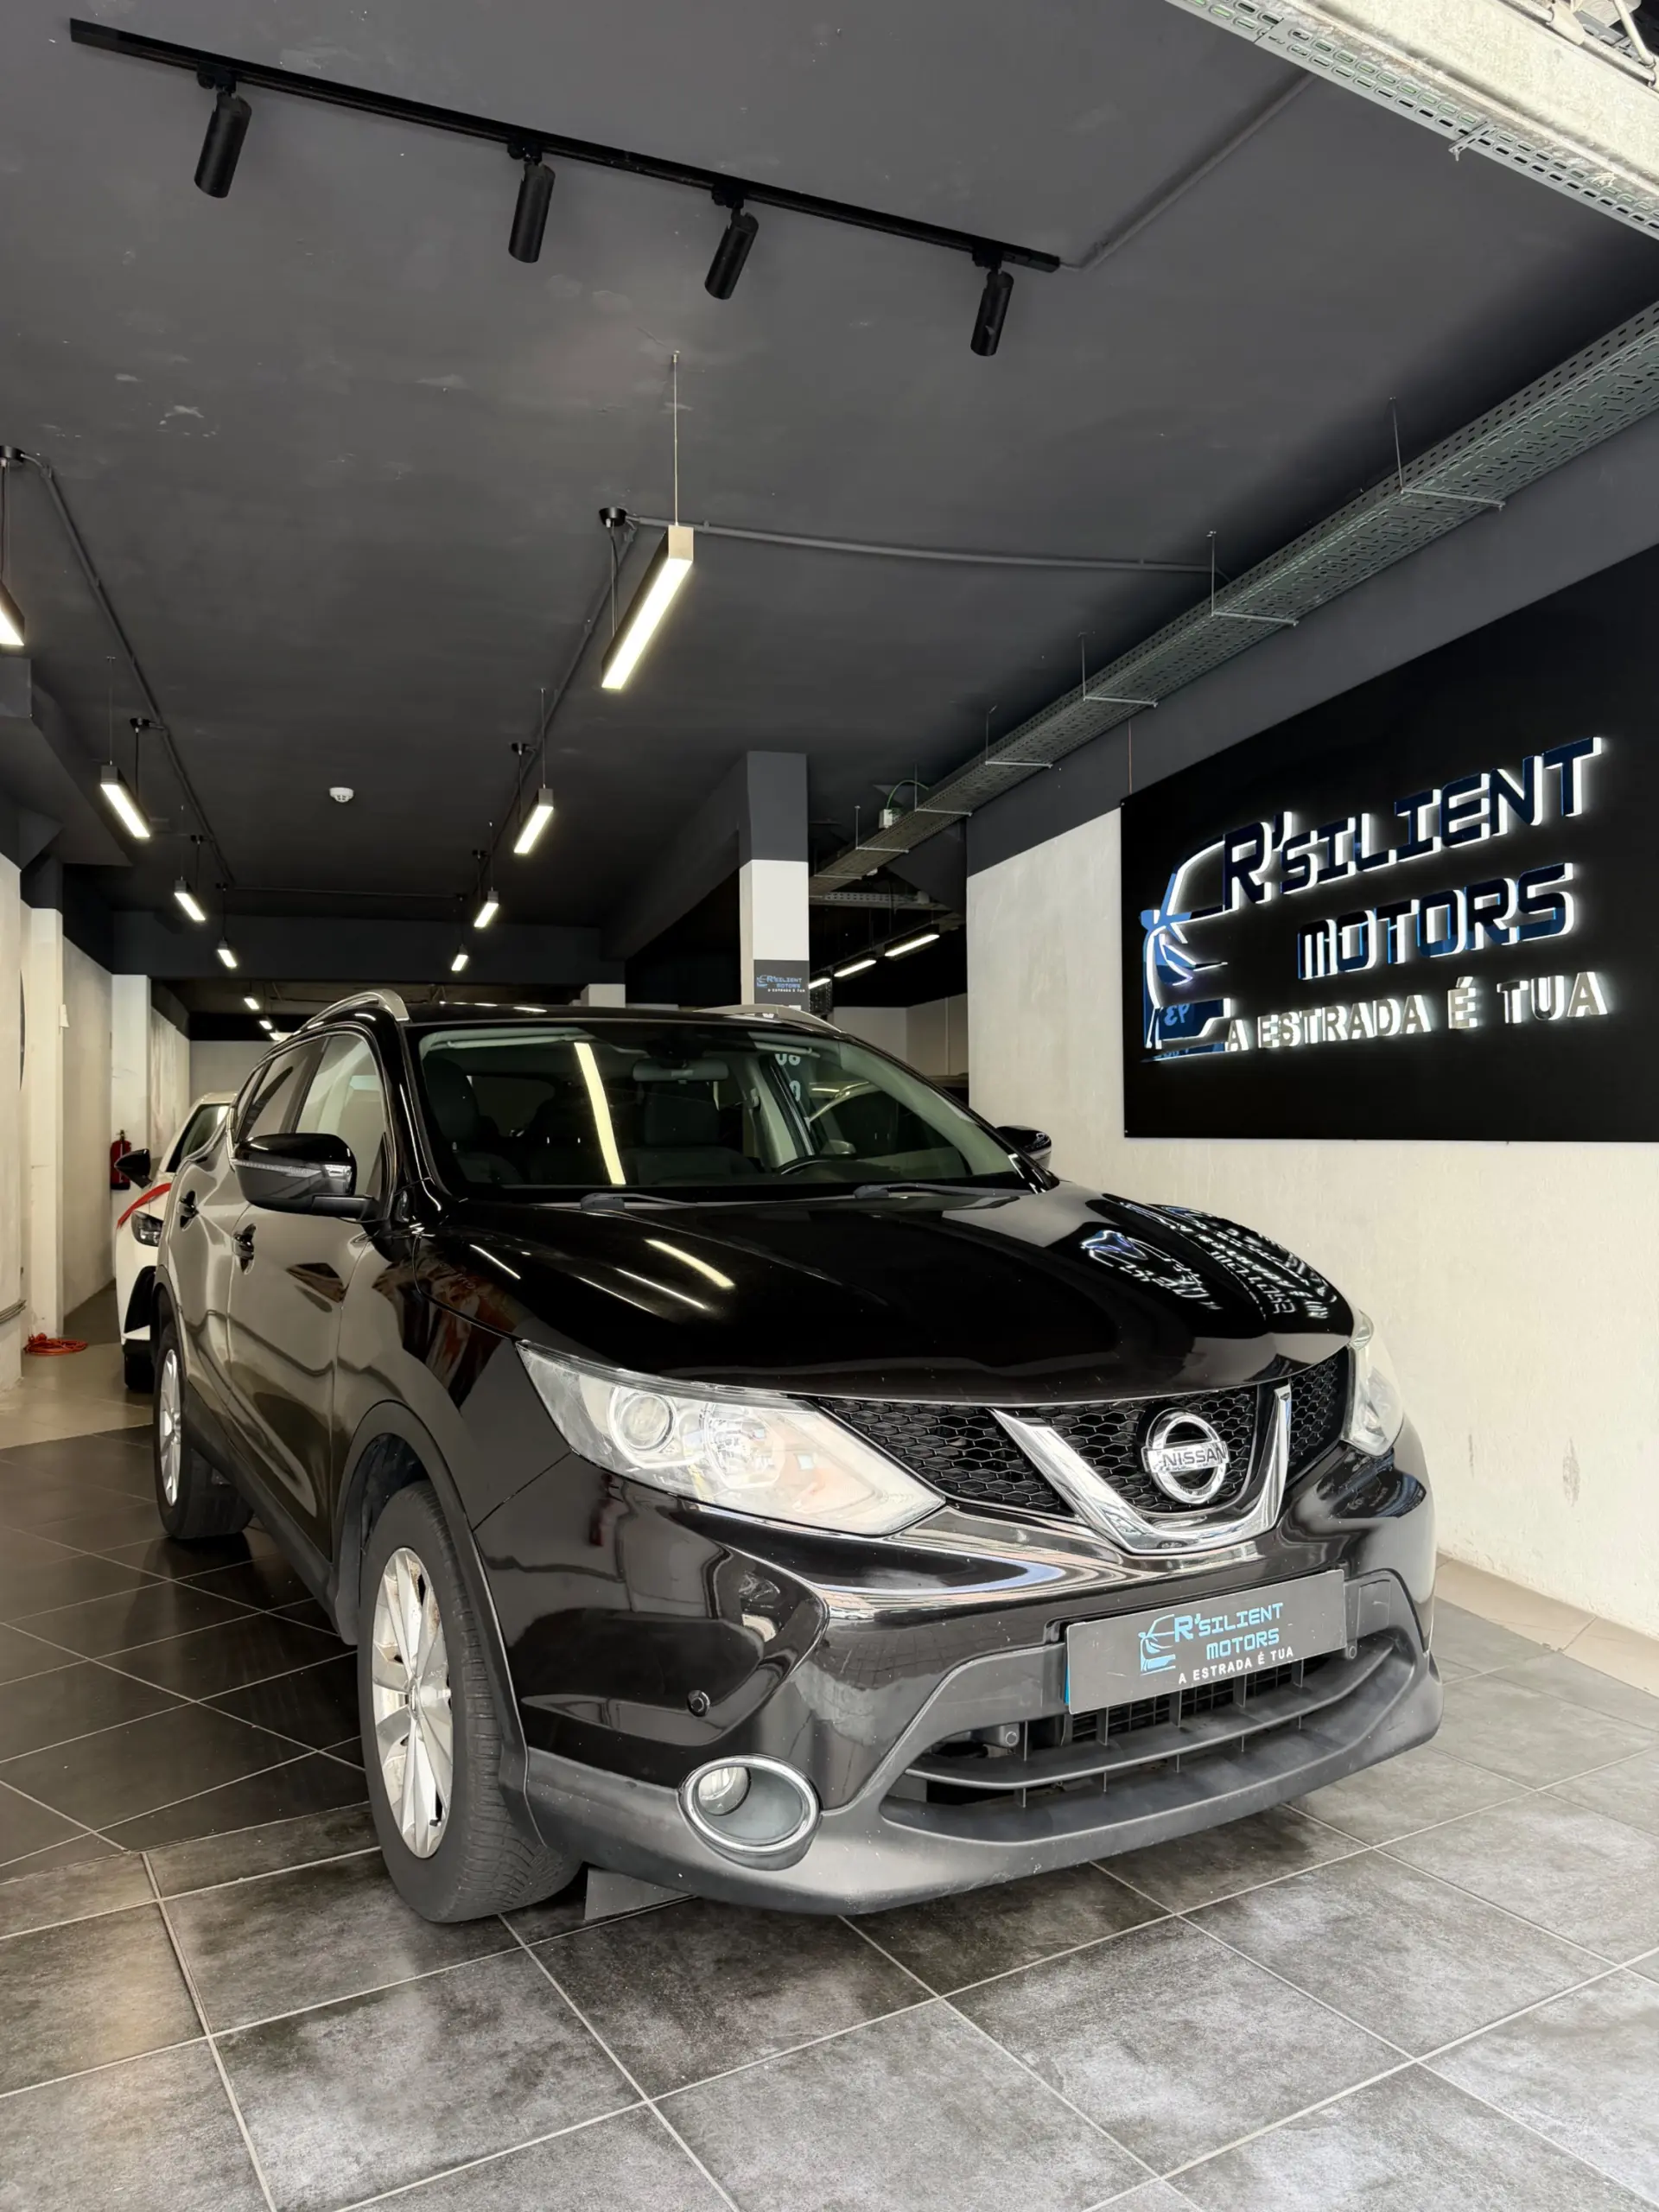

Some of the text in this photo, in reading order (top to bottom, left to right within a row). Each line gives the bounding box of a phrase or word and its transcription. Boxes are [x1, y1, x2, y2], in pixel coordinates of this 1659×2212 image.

[1224, 736, 1603, 912] R'SILIENT
[1298, 862, 1574, 980] MOTORS
[1225, 971, 1608, 1052] A ESTRADA É TUA
[1162, 1441, 1227, 1467] NISSAN
[1174, 1603, 1284, 1643] R'SILIENT
[1206, 1628, 1280, 1660] MOTORS
[1179, 1646, 1294, 1684] A ESTRADA É TUA
